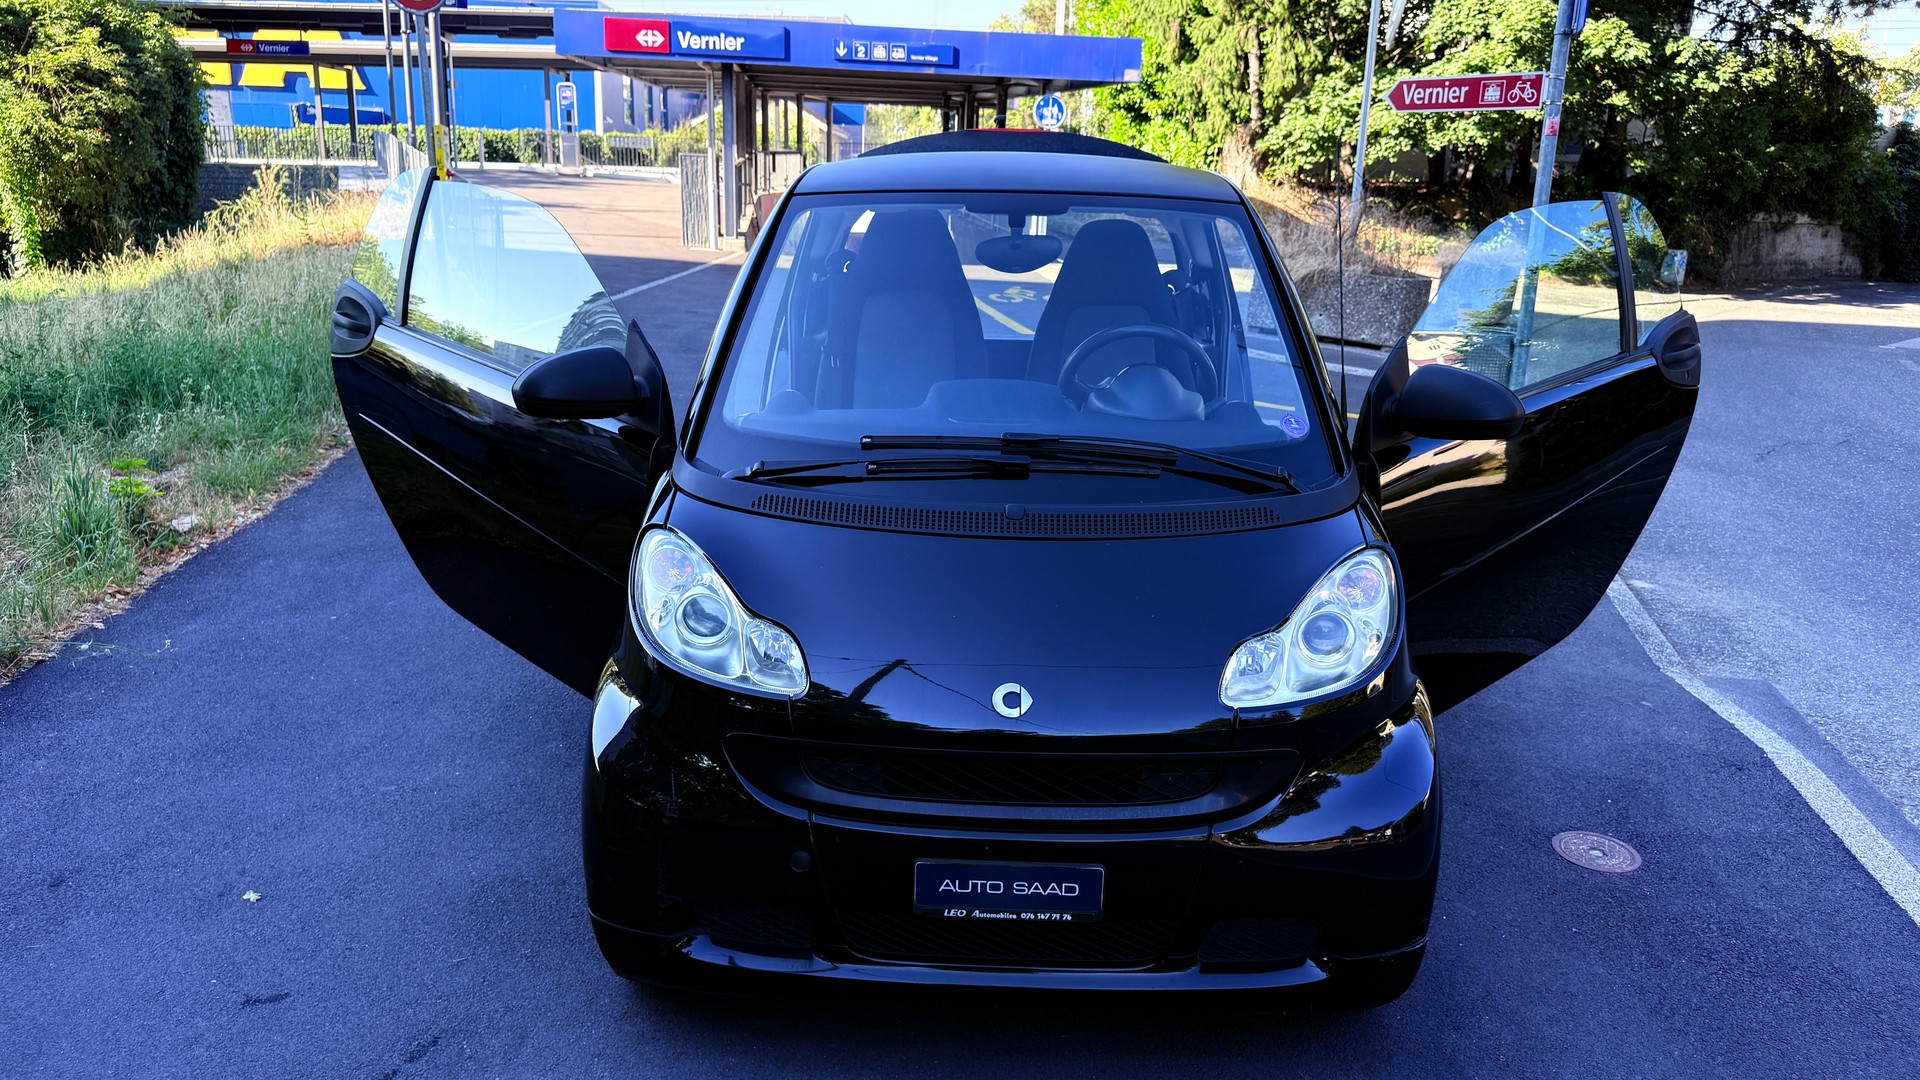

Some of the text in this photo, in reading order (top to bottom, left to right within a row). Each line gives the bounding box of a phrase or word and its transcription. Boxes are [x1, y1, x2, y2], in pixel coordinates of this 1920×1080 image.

[258, 43, 290, 53] Vernier
[677, 30, 745, 51] Vernier
[857, 45, 866, 58] 2
[1402, 81, 1469, 105] Vernier
[938, 879, 1080, 896] AUTO SAAD
[944, 908, 967, 918] LEO
[971, 909, 1017, 920] Automobiles
[1020, 912, 1035, 920] 076
